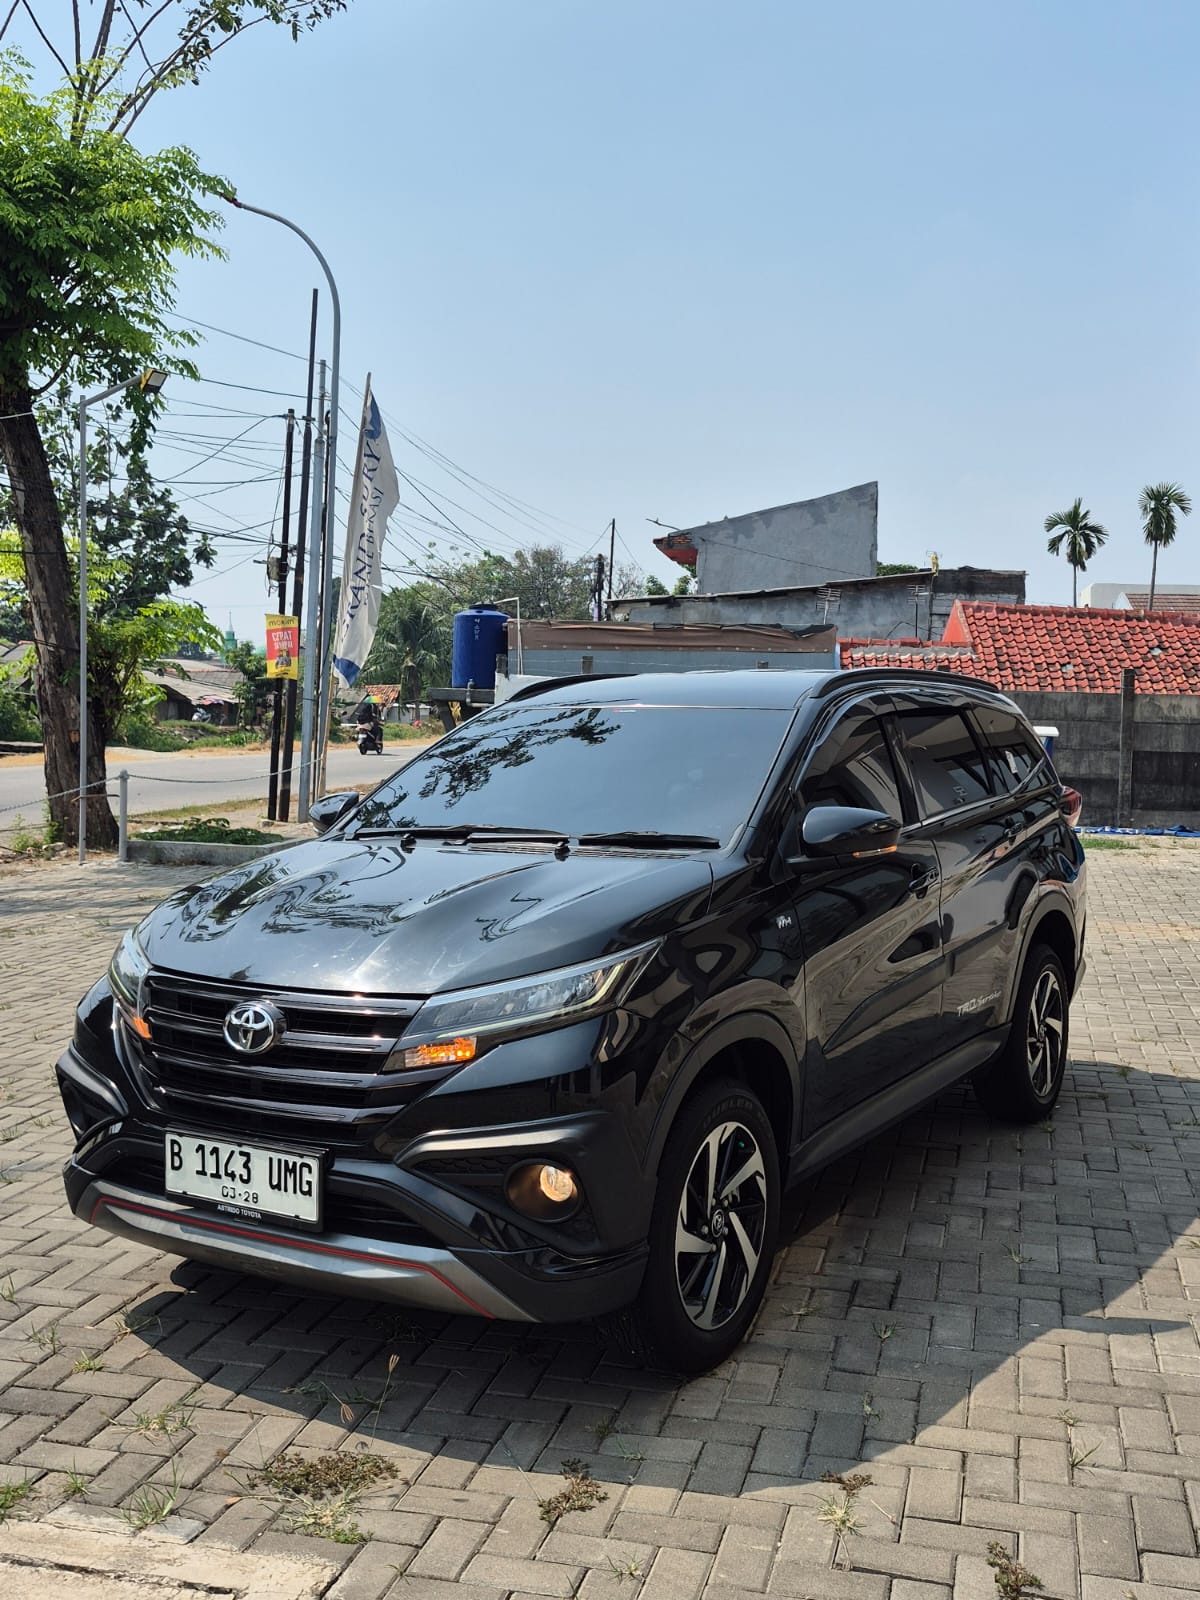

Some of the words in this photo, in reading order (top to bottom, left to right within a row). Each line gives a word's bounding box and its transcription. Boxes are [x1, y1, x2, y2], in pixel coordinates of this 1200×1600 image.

[170, 1138, 183, 1171] B
[195, 1143, 251, 1184] 1143
[268, 1156, 313, 1197] UMG
[241, 1209, 262, 1220] TOYOTA
